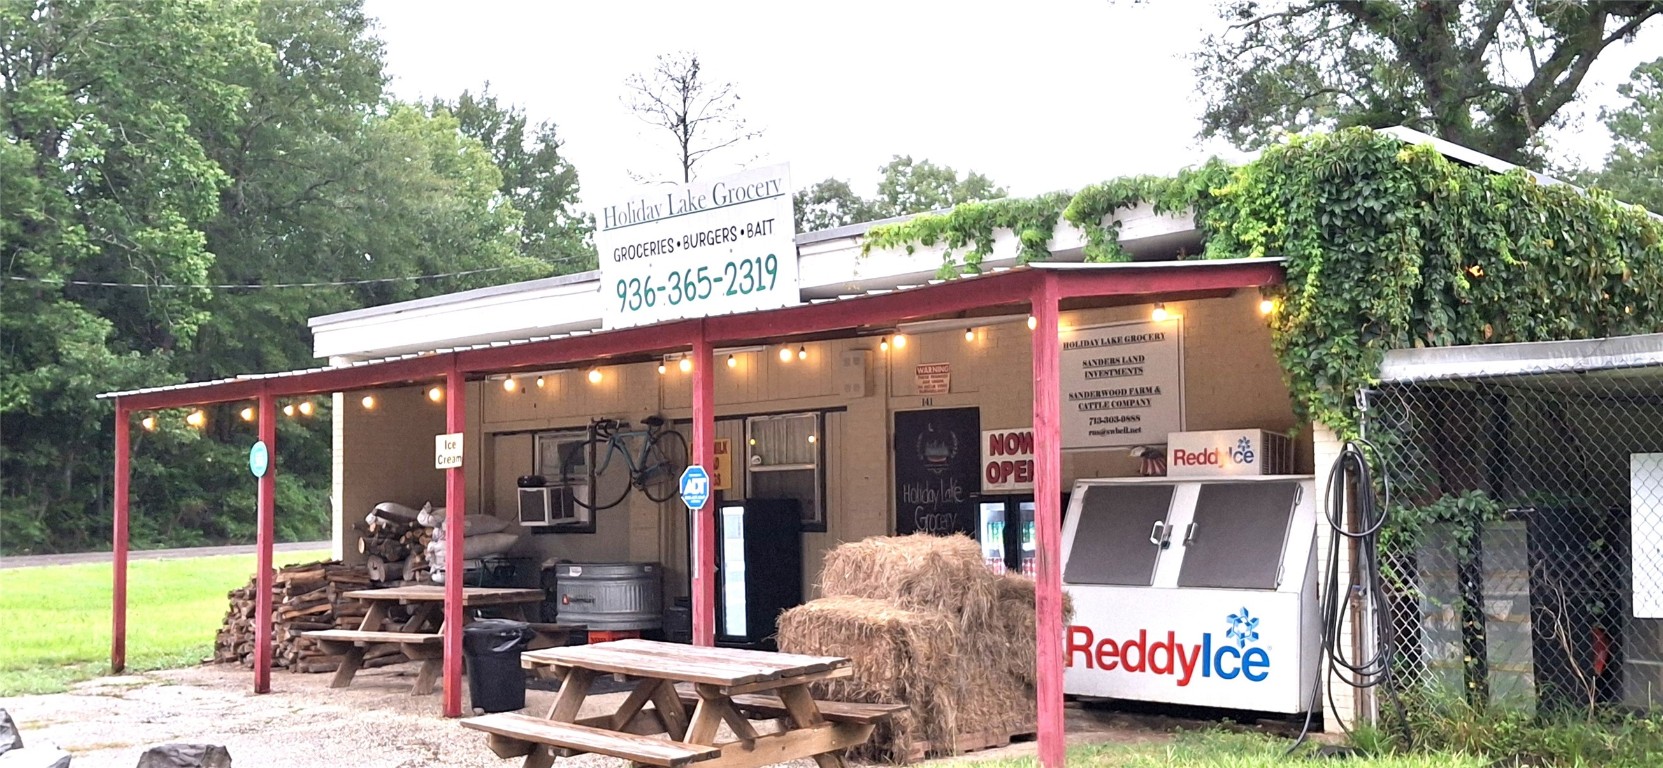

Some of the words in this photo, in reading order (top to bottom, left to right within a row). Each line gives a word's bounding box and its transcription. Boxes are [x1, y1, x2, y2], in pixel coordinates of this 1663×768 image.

[603, 199, 663, 229] Holiday
[667, 189, 707, 216] Lake
[712, 178, 782, 207] Grocery
[613, 238, 674, 262] GROCERIES
[683, 226, 737, 250] BURGERS
[746, 219, 776, 238] BAIT
[616, 253, 778, 312] 936-365-2319
[1063, 338, 1101, 350] HOLIDAY
[1100, 336, 1123, 346] LAKE
[1124, 332, 1166, 343] GROCERY
[1082, 357, 1120, 368] SANDERS
[1122, 355, 1145, 365] LAND
[916, 365, 949, 374] WARNING
[1084, 367, 1143, 379] INVESTMENTS
[1068, 388, 1127, 400] SANDERWOOD
[1129, 387, 1153, 397] FARM
[1154, 386, 1161, 395] &
[922, 397, 933, 406] 141
[1078, 400, 1110, 411] CATTLE
[1111, 399, 1151, 410] COMPANY
[444, 439, 457, 450] Ice
[437, 454, 462, 465] Cream
[684, 477, 707, 495] ADT
[903, 480, 940, 510] Holiday
[940, 477, 965, 503] Lake
[914, 505, 958, 532] Grocery
